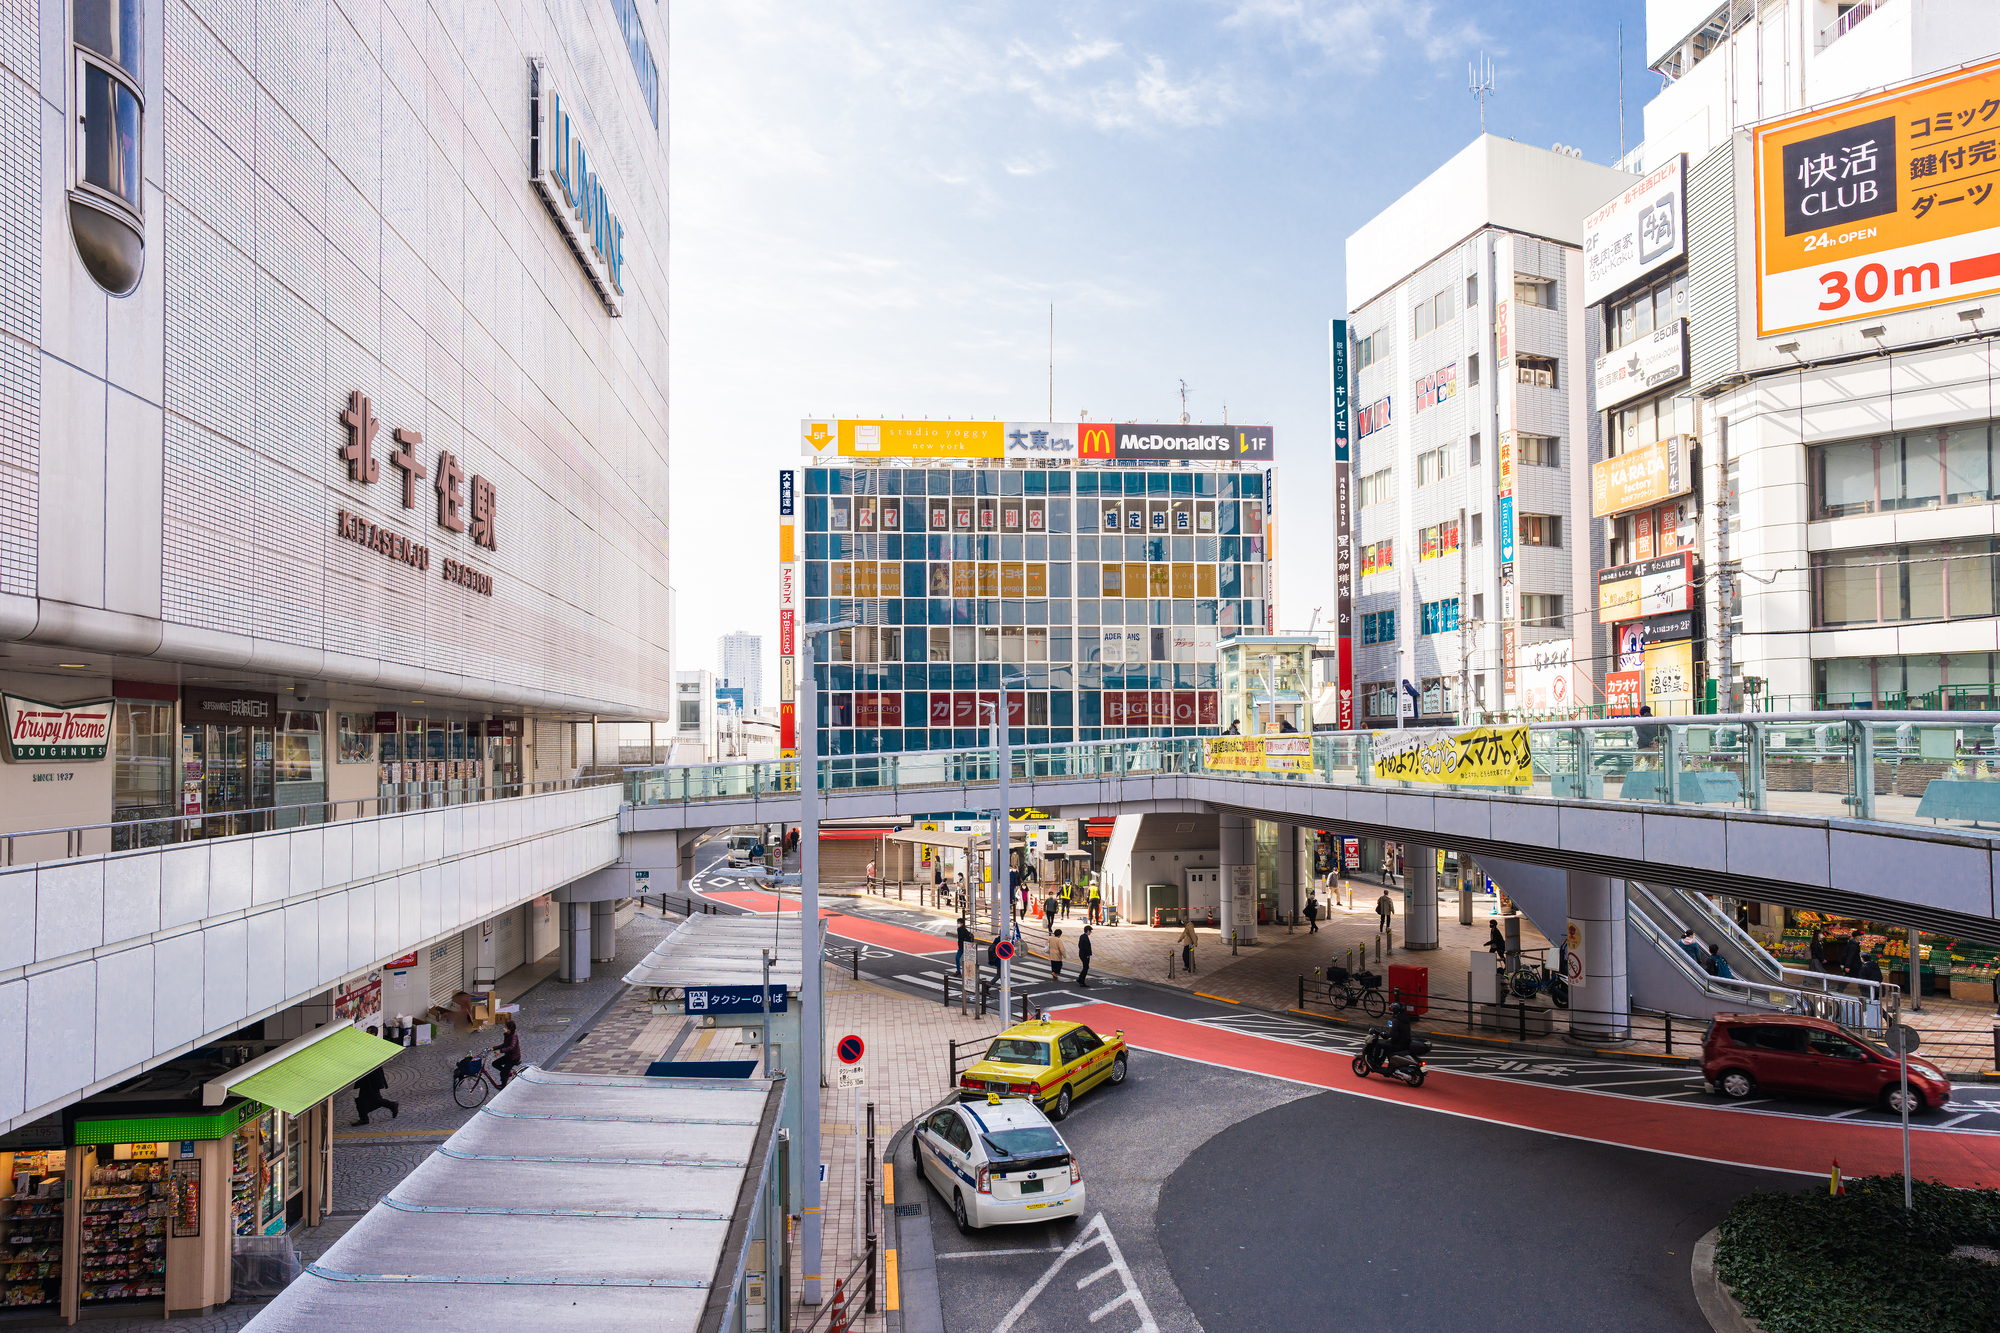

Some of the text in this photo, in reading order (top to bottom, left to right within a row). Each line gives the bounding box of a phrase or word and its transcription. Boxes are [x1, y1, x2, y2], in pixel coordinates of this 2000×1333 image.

[1910, 98, 2000, 140] コミック
[1797, 139, 1879, 189] 快活
[1910, 138, 2000, 180] 鍵付完
[549, 89, 624, 296] LUMINE
[1587, 162, 1677, 230] ビックリヤ 北千住西口ビル
[1800, 179, 1879, 216] CLUB
[1911, 182, 1993, 220] ダーツ
[1643, 211, 1672, 245] 牛角
[1803, 226, 1878, 252] 24h OPEN
[1585, 232, 1599, 254] 2F
[1588, 232, 1634, 270] 焼肉酒家
[1588, 249, 1634, 282] Gyu-Kaku
[1817, 261, 1940, 312] 30m
[1653, 322, 1679, 343] 250席
[1336, 341, 1344, 380] 脱毛サロン
[1596, 358, 1607, 370] 5F
[1335, 385, 1346, 431] キレイモ
[1359, 398, 1390, 437] VR
[813, 432, 826, 440] 5F
[890, 427, 938, 437] studio
[1009, 429, 1074, 452] 大東ビル
[1120, 434, 1230, 451] McDonald's
[939, 442, 966, 451] york
[1250, 437, 1267, 451] 1F
[1501, 443, 1511, 477] 麻雀
[1668, 440, 1678, 476] 当ビル
[341, 390, 498, 551] 北千住駅
[1624, 479, 1652, 494] factory
[1668, 478, 1679, 491] 4F
[1620, 489, 1656, 504] カラダファクトリー
[1106, 512, 1189, 528] 確定申告
[1663, 512, 1676, 548] 整体
[1638, 517, 1650, 553] 骨盤
[339, 509, 493, 597] KITASENJU STATION
[1128, 572, 1169, 580] studio
[1337, 534, 1349, 599] 星乃珈琲店
[1634, 563, 1647, 576] 4F
[872, 583, 900, 591] PELVIS
[782, 611, 793, 620] 3F
[1340, 613, 1350, 623] 2F
[1155, 632, 1164, 641] 4F
[1651, 620, 1691, 635] 入口はコチラ 2F
[1607, 678, 1638, 693] カラオケ
[1650, 674, 1682, 694] 温野菜
[231, 698, 268, 717] 成城石井
[1607, 692, 1638, 709] 歌広場
[1341, 700, 1351, 730] アイフ
[13, 710, 108, 744] Krispy Kreme
[17, 747, 103, 757] DOUGHNUTS
[32, 772, 74, 782] SINCE 1937
[133, 1150, 156, 1158] おすすめ
